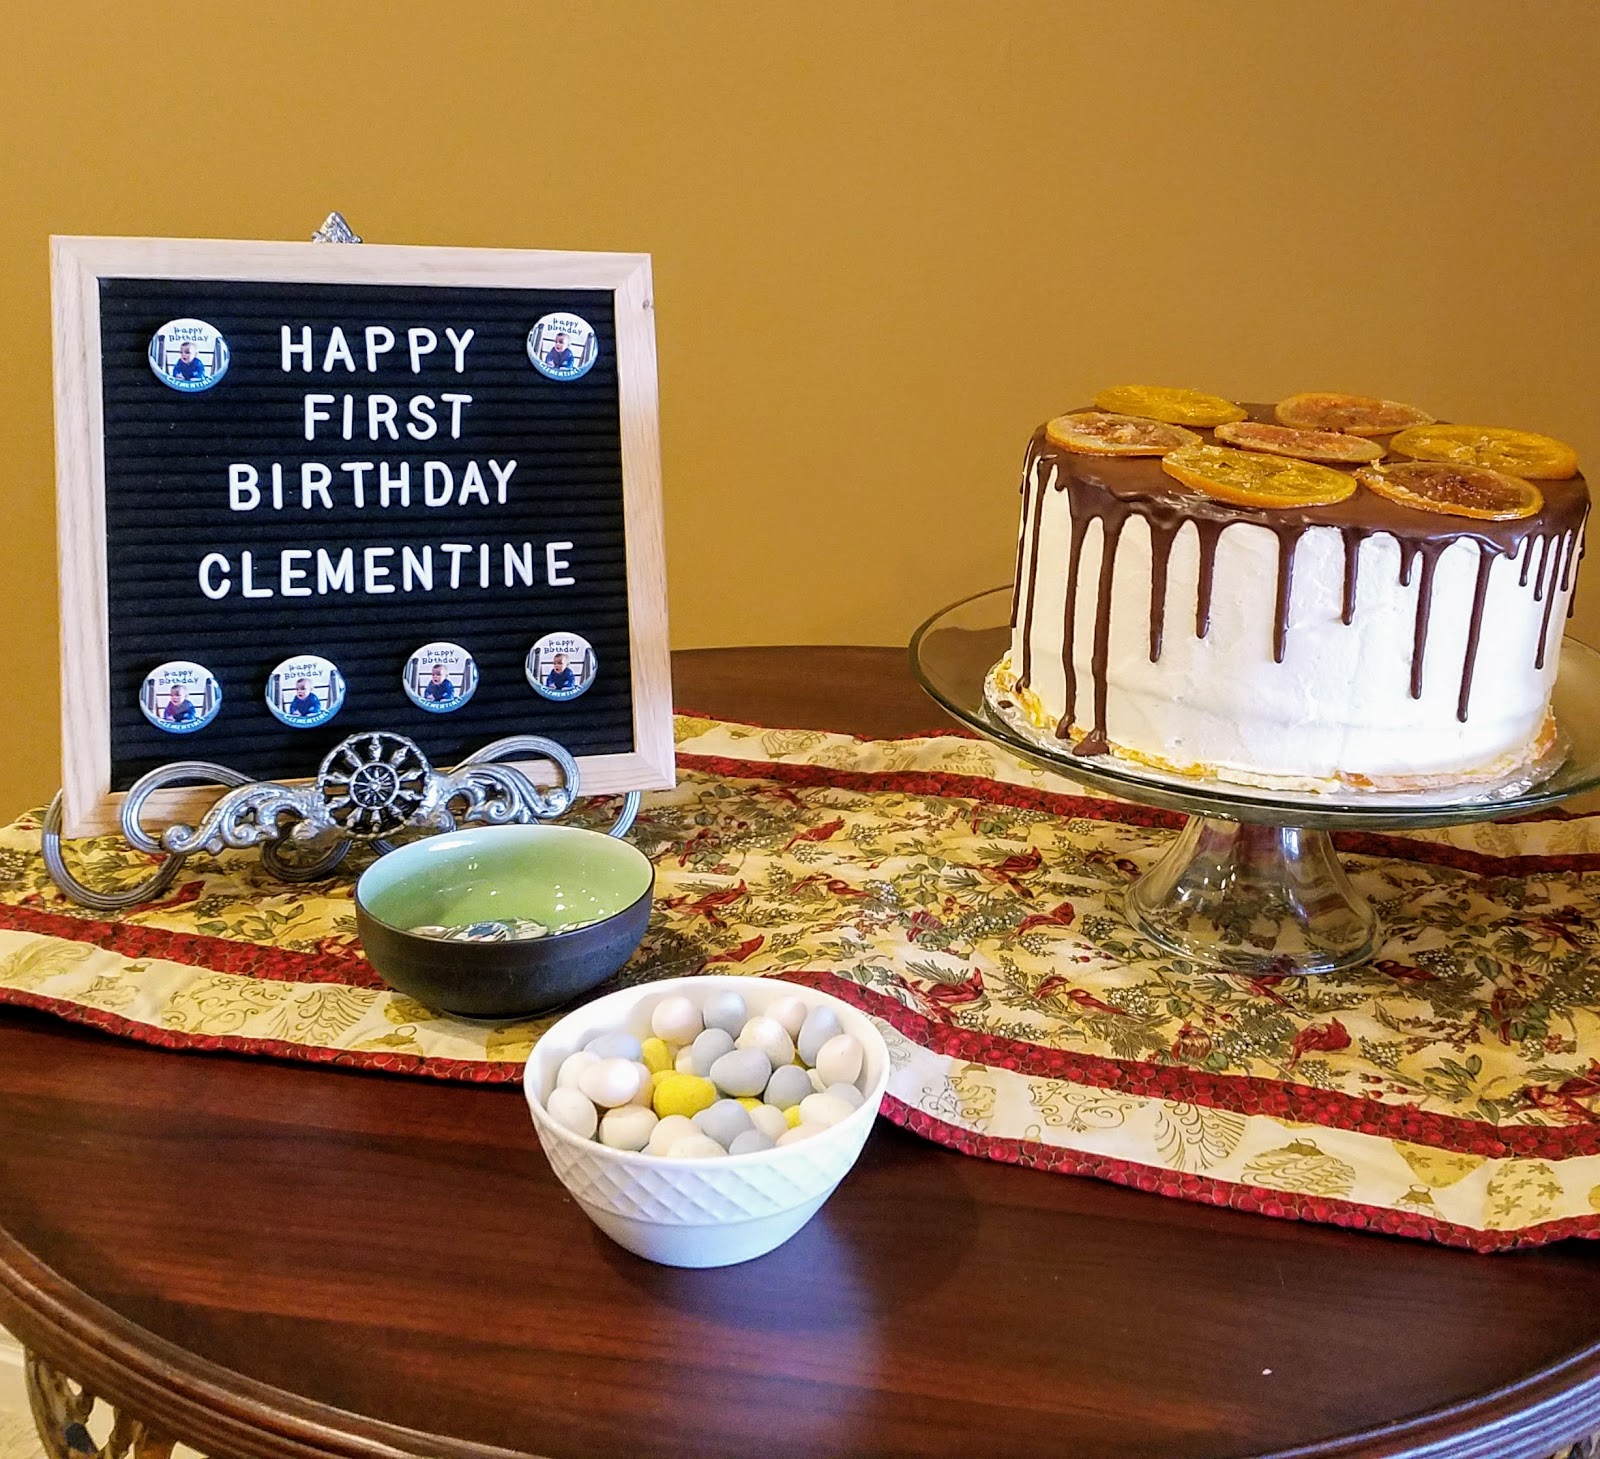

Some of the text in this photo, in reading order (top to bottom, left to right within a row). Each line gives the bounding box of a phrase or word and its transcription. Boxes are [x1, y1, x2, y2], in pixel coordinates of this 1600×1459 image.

[281, 325, 475, 374] HAPPY
[304, 393, 473, 441] FIRST
[228, 459, 518, 511] BIRTHDAY
[198, 541, 576, 598] CLEMENTINE
